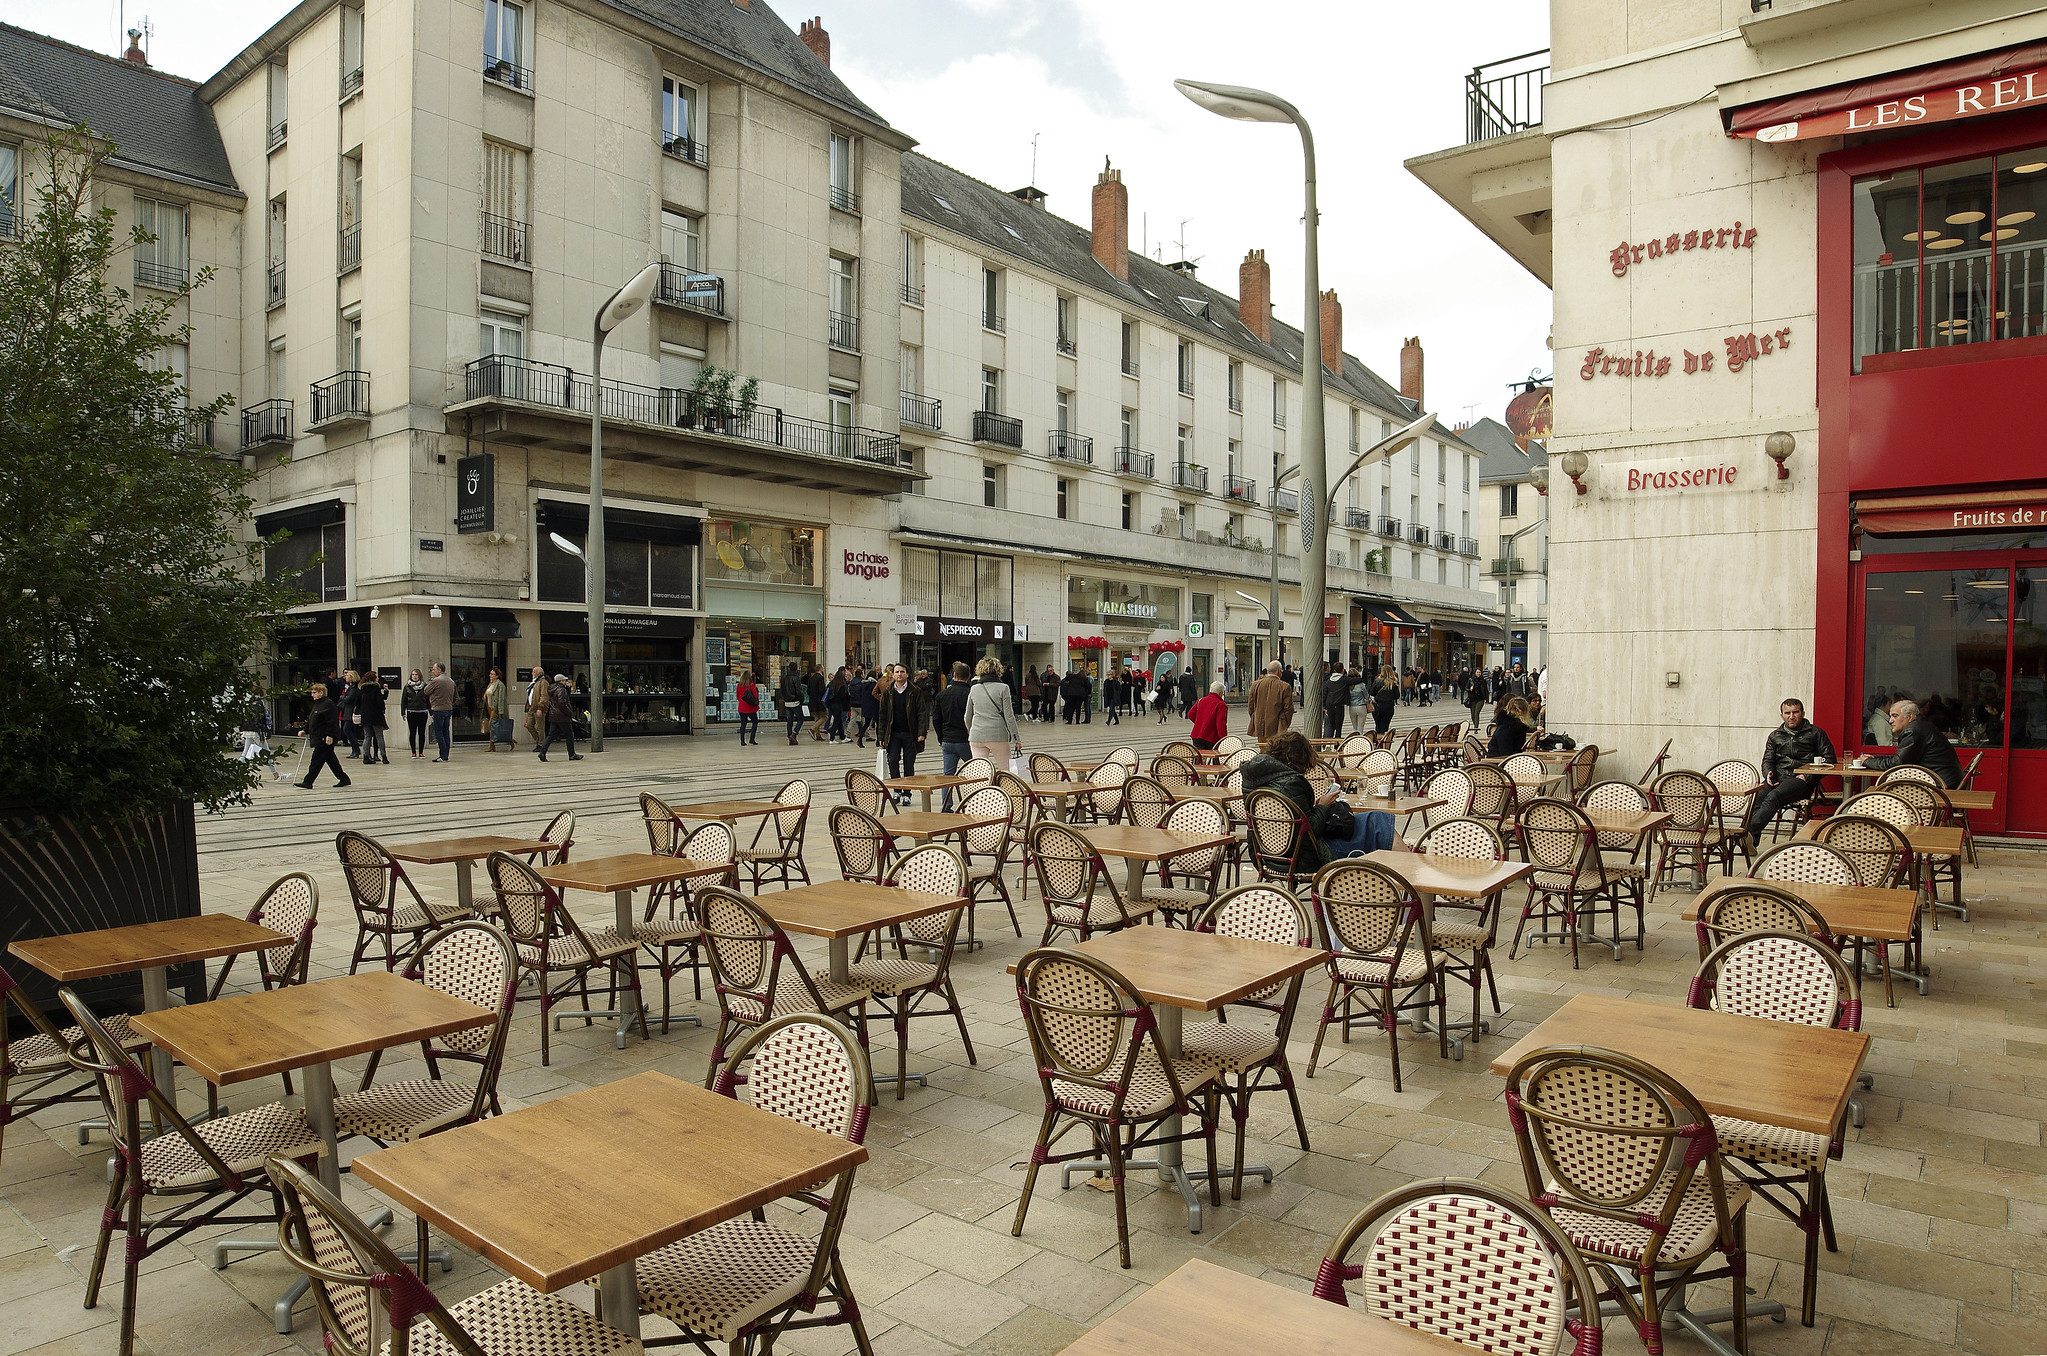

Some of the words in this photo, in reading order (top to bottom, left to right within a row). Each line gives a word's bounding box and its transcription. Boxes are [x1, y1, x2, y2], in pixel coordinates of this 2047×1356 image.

[1845, 95, 1928, 130] LES
[1609, 220, 1758, 278] Brasserie
[1580, 347, 1672, 380] Fruits
[1683, 348, 1714, 375] de
[1723, 327, 1791, 373] Mer
[1627, 462, 1738, 491] Brasserie
[1953, 510, 2006, 527] Fruits
[2011, 507, 2034, 523] de
[844, 549, 855, 562] la
[856, 551, 889, 565] chaise
[844, 563, 890, 580] longue
[1095, 600, 1158, 617] PARASHOP
[939, 622, 982, 636] NESPRESSO
